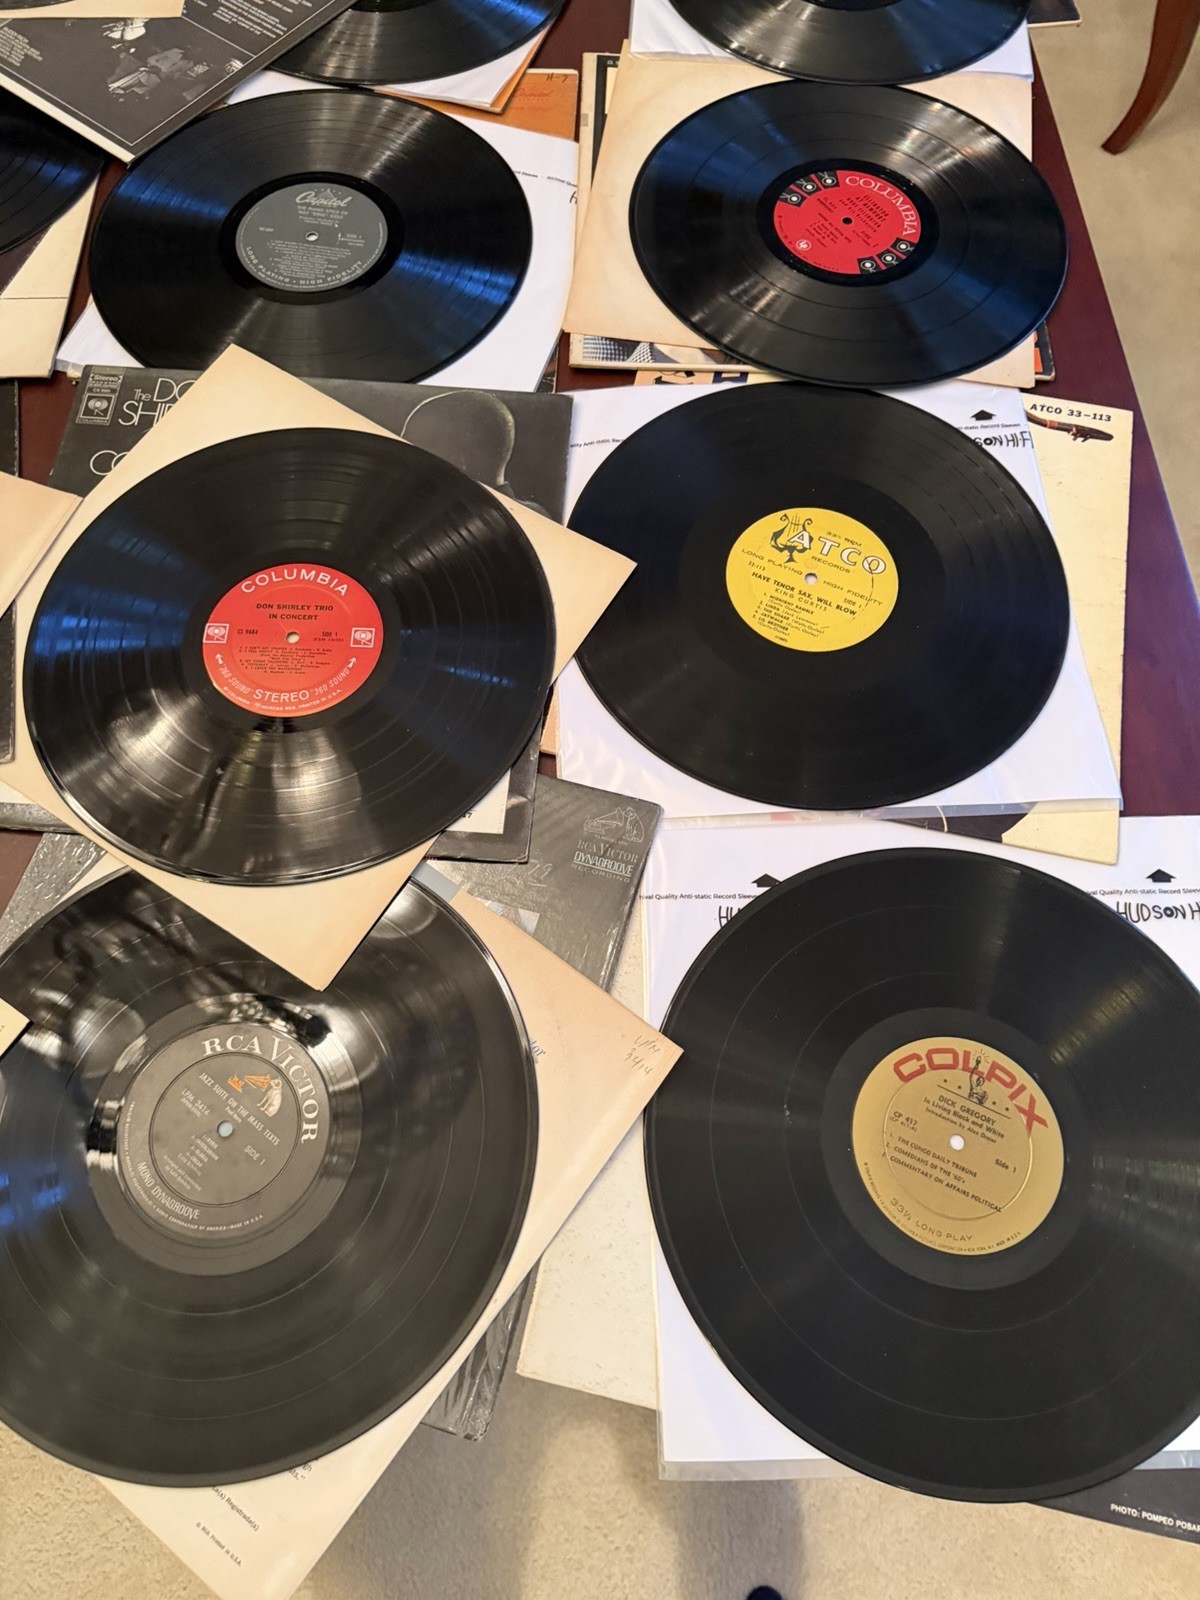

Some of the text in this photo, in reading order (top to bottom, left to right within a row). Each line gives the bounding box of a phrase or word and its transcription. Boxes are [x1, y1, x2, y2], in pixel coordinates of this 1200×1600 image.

[295, 190, 352, 207] Capitol
[846, 176, 918, 236] COLUMBIA
[246, 246, 258, 264] LONG
[258, 264, 290, 282] PLAYING
[327, 260, 362, 282] FIDELITY
[94, 373, 118, 382] Stereo
[134, 389, 152, 402] The
[1030, 403, 1112, 422] ATCO 33-113
[788, 529, 886, 575] ATCO
[811, 555, 851, 574] RECORDS
[241, 568, 348, 596] COLUMBIA
[741, 548, 884, 606] LONG PLAYING HIGH FIDELITY
[752, 572, 857, 616] HAVE TENOR SAX, WILL BLOW
[774, 588, 828, 612] KING CURTIS
[843, 597, 858, 606] SIDE
[252, 688, 310, 703] STEREO
[574, 850, 634, 876] DYNAGROOVE
[577, 840, 597, 852] RCA
[600, 843, 639, 864] VICTOR
[571, 864, 631, 883] RECORDING
[1099, 888, 1122, 896] Quality
[1116, 901, 1186, 924] HUDSON
[202, 1034, 319, 1144] RCA VICTOR
[893, 1047, 1049, 1139] COLPIX
[182, 1088, 196, 1104] LPM
[194, 1098, 210, 1116] 3414
[199, 1072, 280, 1146] JAZZ SUITE ON THE MASS TEXTS
[938, 1094, 997, 1126] DICK GREGORY
[893, 1110, 918, 1126] CP 417
[924, 1096, 1006, 1139] In Living Black and White
[926, 1108, 979, 1136] Introduction by Alex
[244, 1145, 260, 1160] SIDE
[894, 1146, 929, 1166] COMEDIANS
[930, 1162, 938, 1170] OF
[939, 1166, 954, 1177] THE
[898, 1136, 910, 1146] THE
[910, 1142, 932, 1156] CONGO
[932, 1152, 951, 1165] DAILY
[952, 1162, 978, 1178] TRIBUNE
[994, 1158, 1010, 1170] Side
[138, 1161, 155, 1188] MONO
[152, 1186, 200, 1220] DYNAGROOVE
[890, 1156, 932, 1180] COMMENTARY
[934, 1176, 944, 1185] ON
[945, 1181, 970, 1198] AFFAIRS
[970, 1194, 1002, 1213] POLITICAL
[916, 1220, 943, 1238] LONG
[946, 1232, 973, 1242] PLAY
[226, 1496, 260, 1532] Registrada(s)
[1110, 1503, 1141, 1518] PHOTO:
[1141, 1511, 1174, 1526] POMPEO
[202, 1526, 210, 1536] RCA
[210, 1534, 226, 1550] Printed
